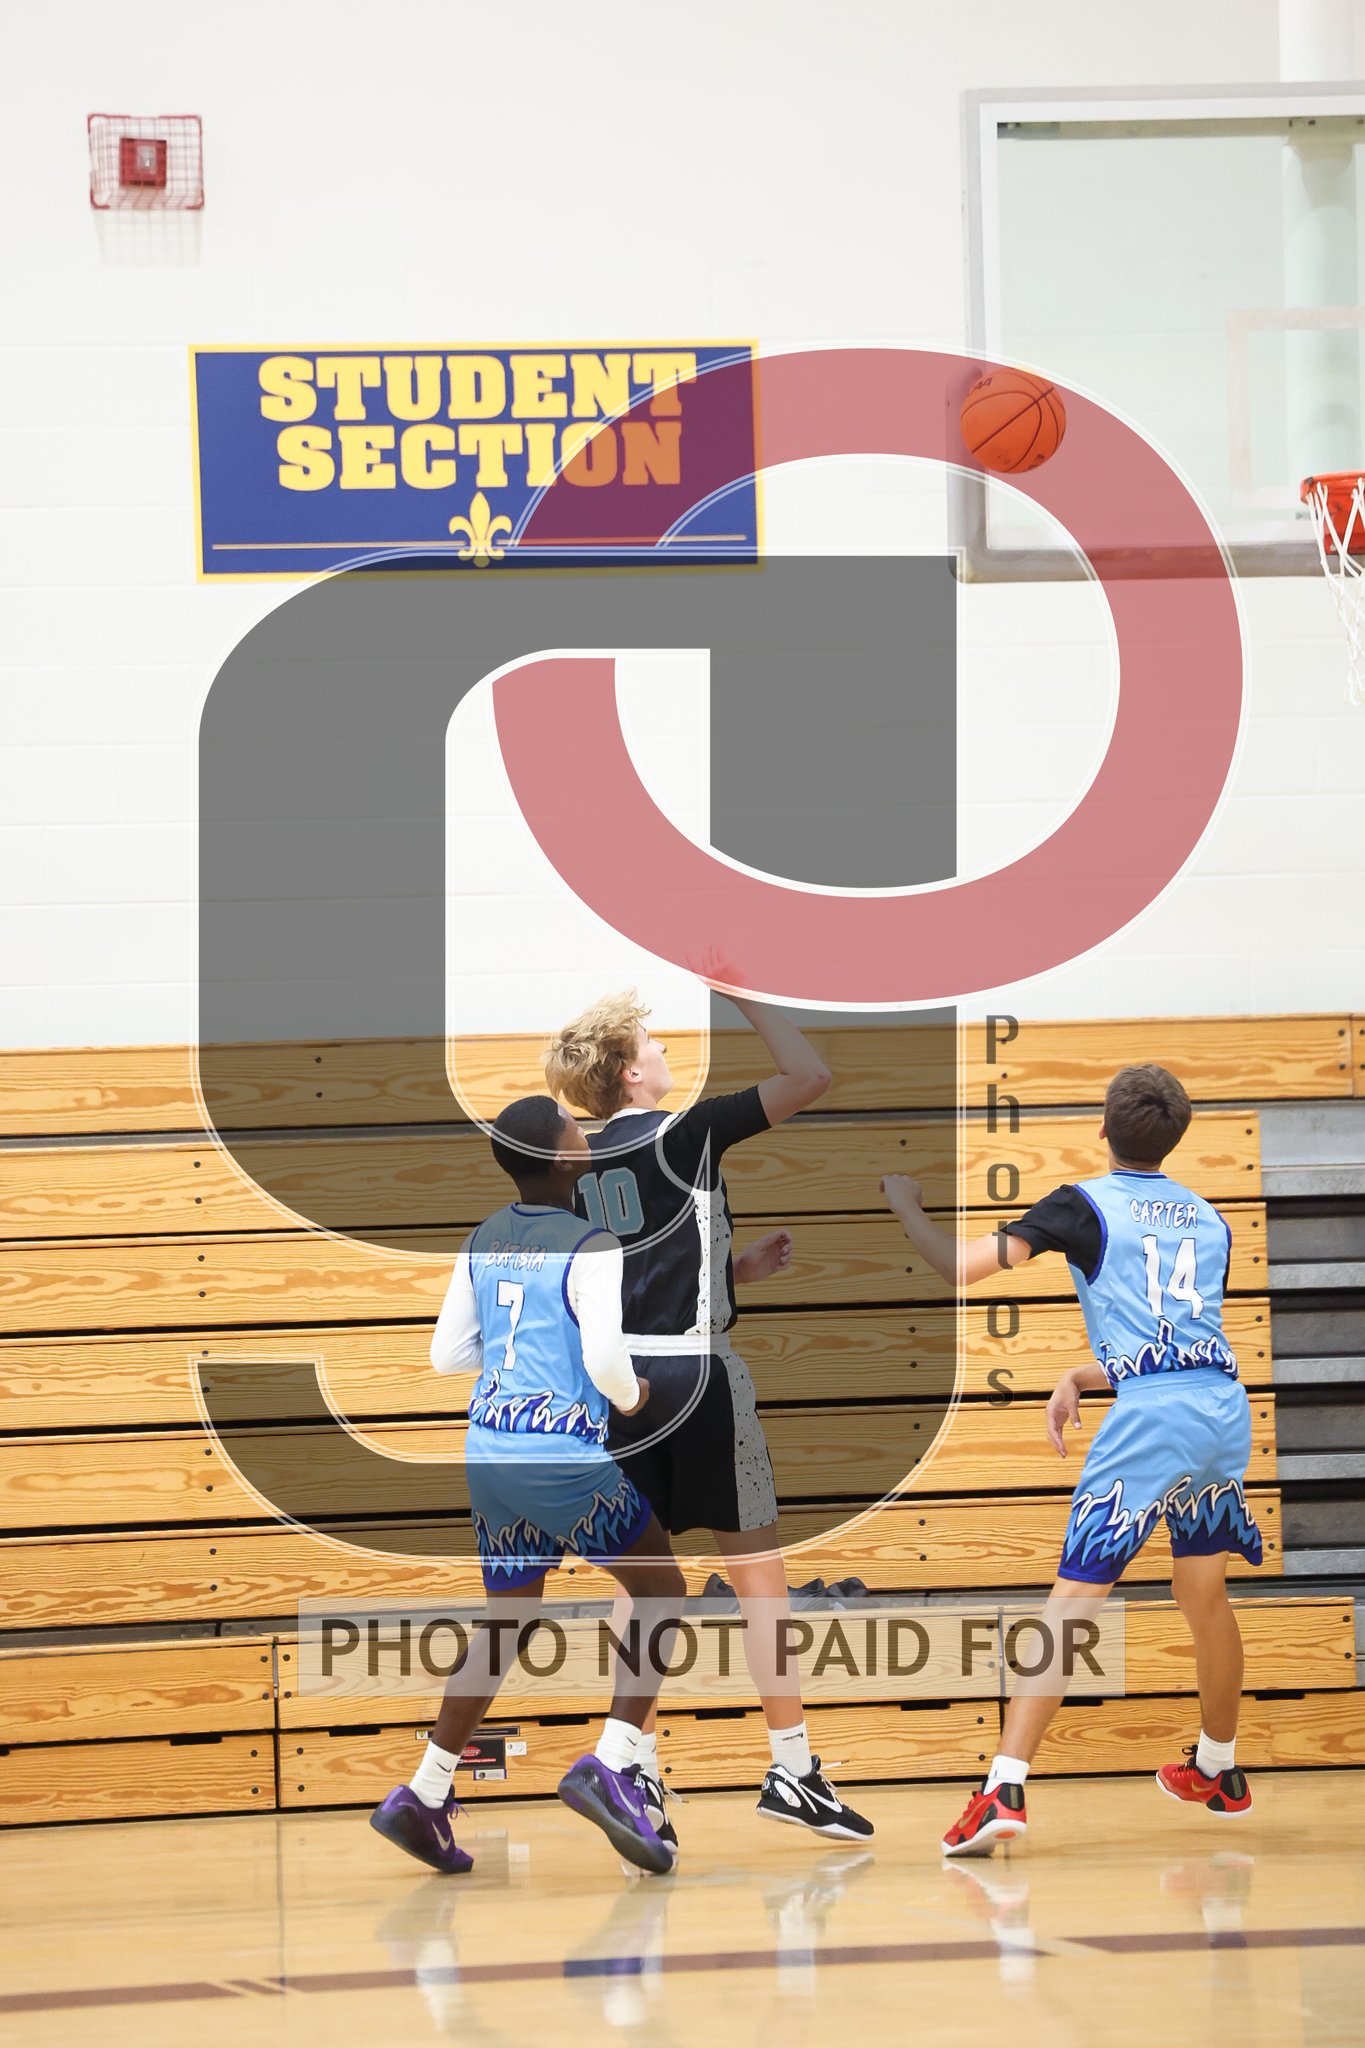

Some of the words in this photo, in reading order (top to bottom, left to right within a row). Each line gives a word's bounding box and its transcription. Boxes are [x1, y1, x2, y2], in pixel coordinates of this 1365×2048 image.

[258, 353, 697, 422] STUDENT
[277, 421, 682, 491] SECTION
[577, 1166, 645, 1237] 10
[1129, 1199, 1199, 1229] CARTER
[484, 1238, 548, 1273] BATISTA
[1141, 1233, 1204, 1320] 14
[496, 1279, 525, 1371] 7
